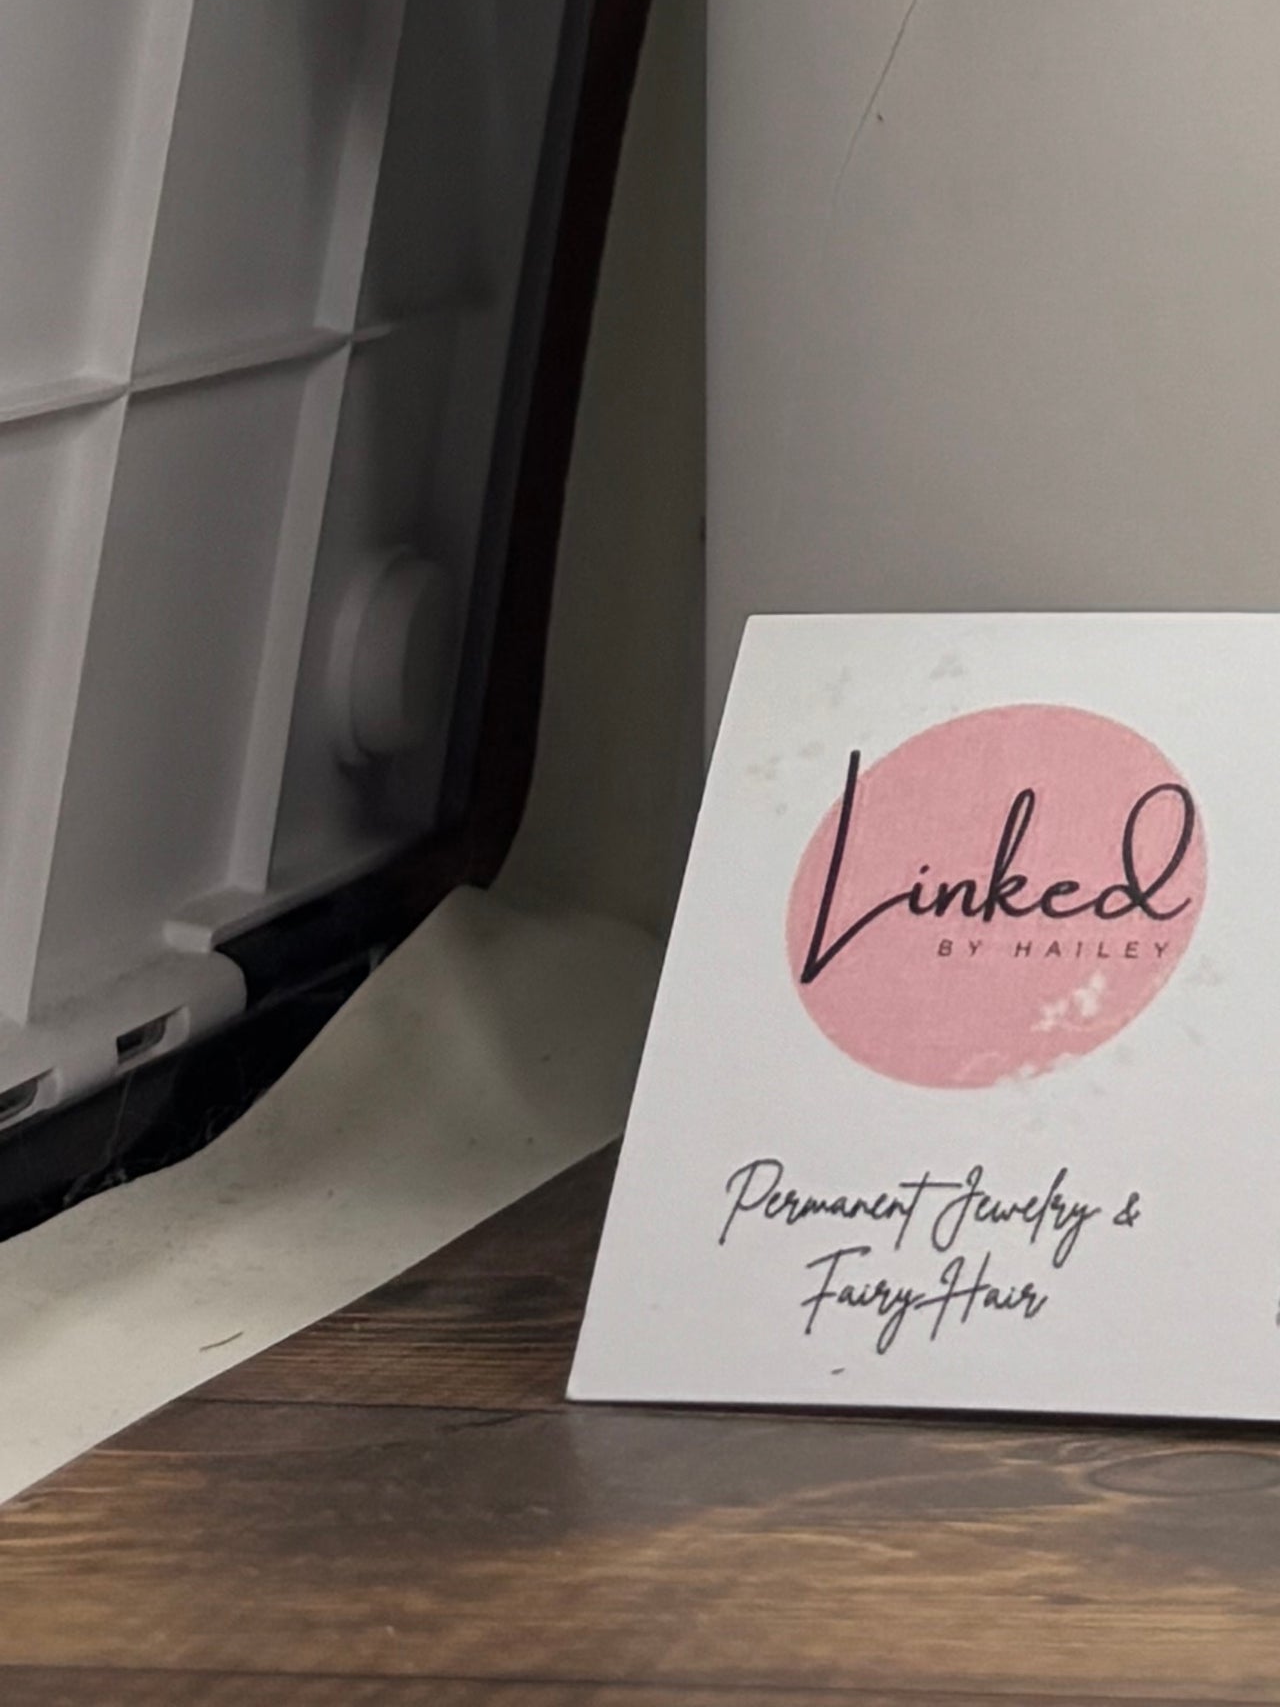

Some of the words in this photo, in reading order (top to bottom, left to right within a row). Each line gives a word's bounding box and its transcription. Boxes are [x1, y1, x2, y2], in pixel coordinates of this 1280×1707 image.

[799, 749, 1195, 984] Linked
[936, 938, 983, 959] BY
[1013, 938, 1171, 961] HAILEY
[718, 1157, 964, 1246] Permanent
[931, 1163, 1102, 1268] Jewelry
[1112, 1190, 1143, 1228] &
